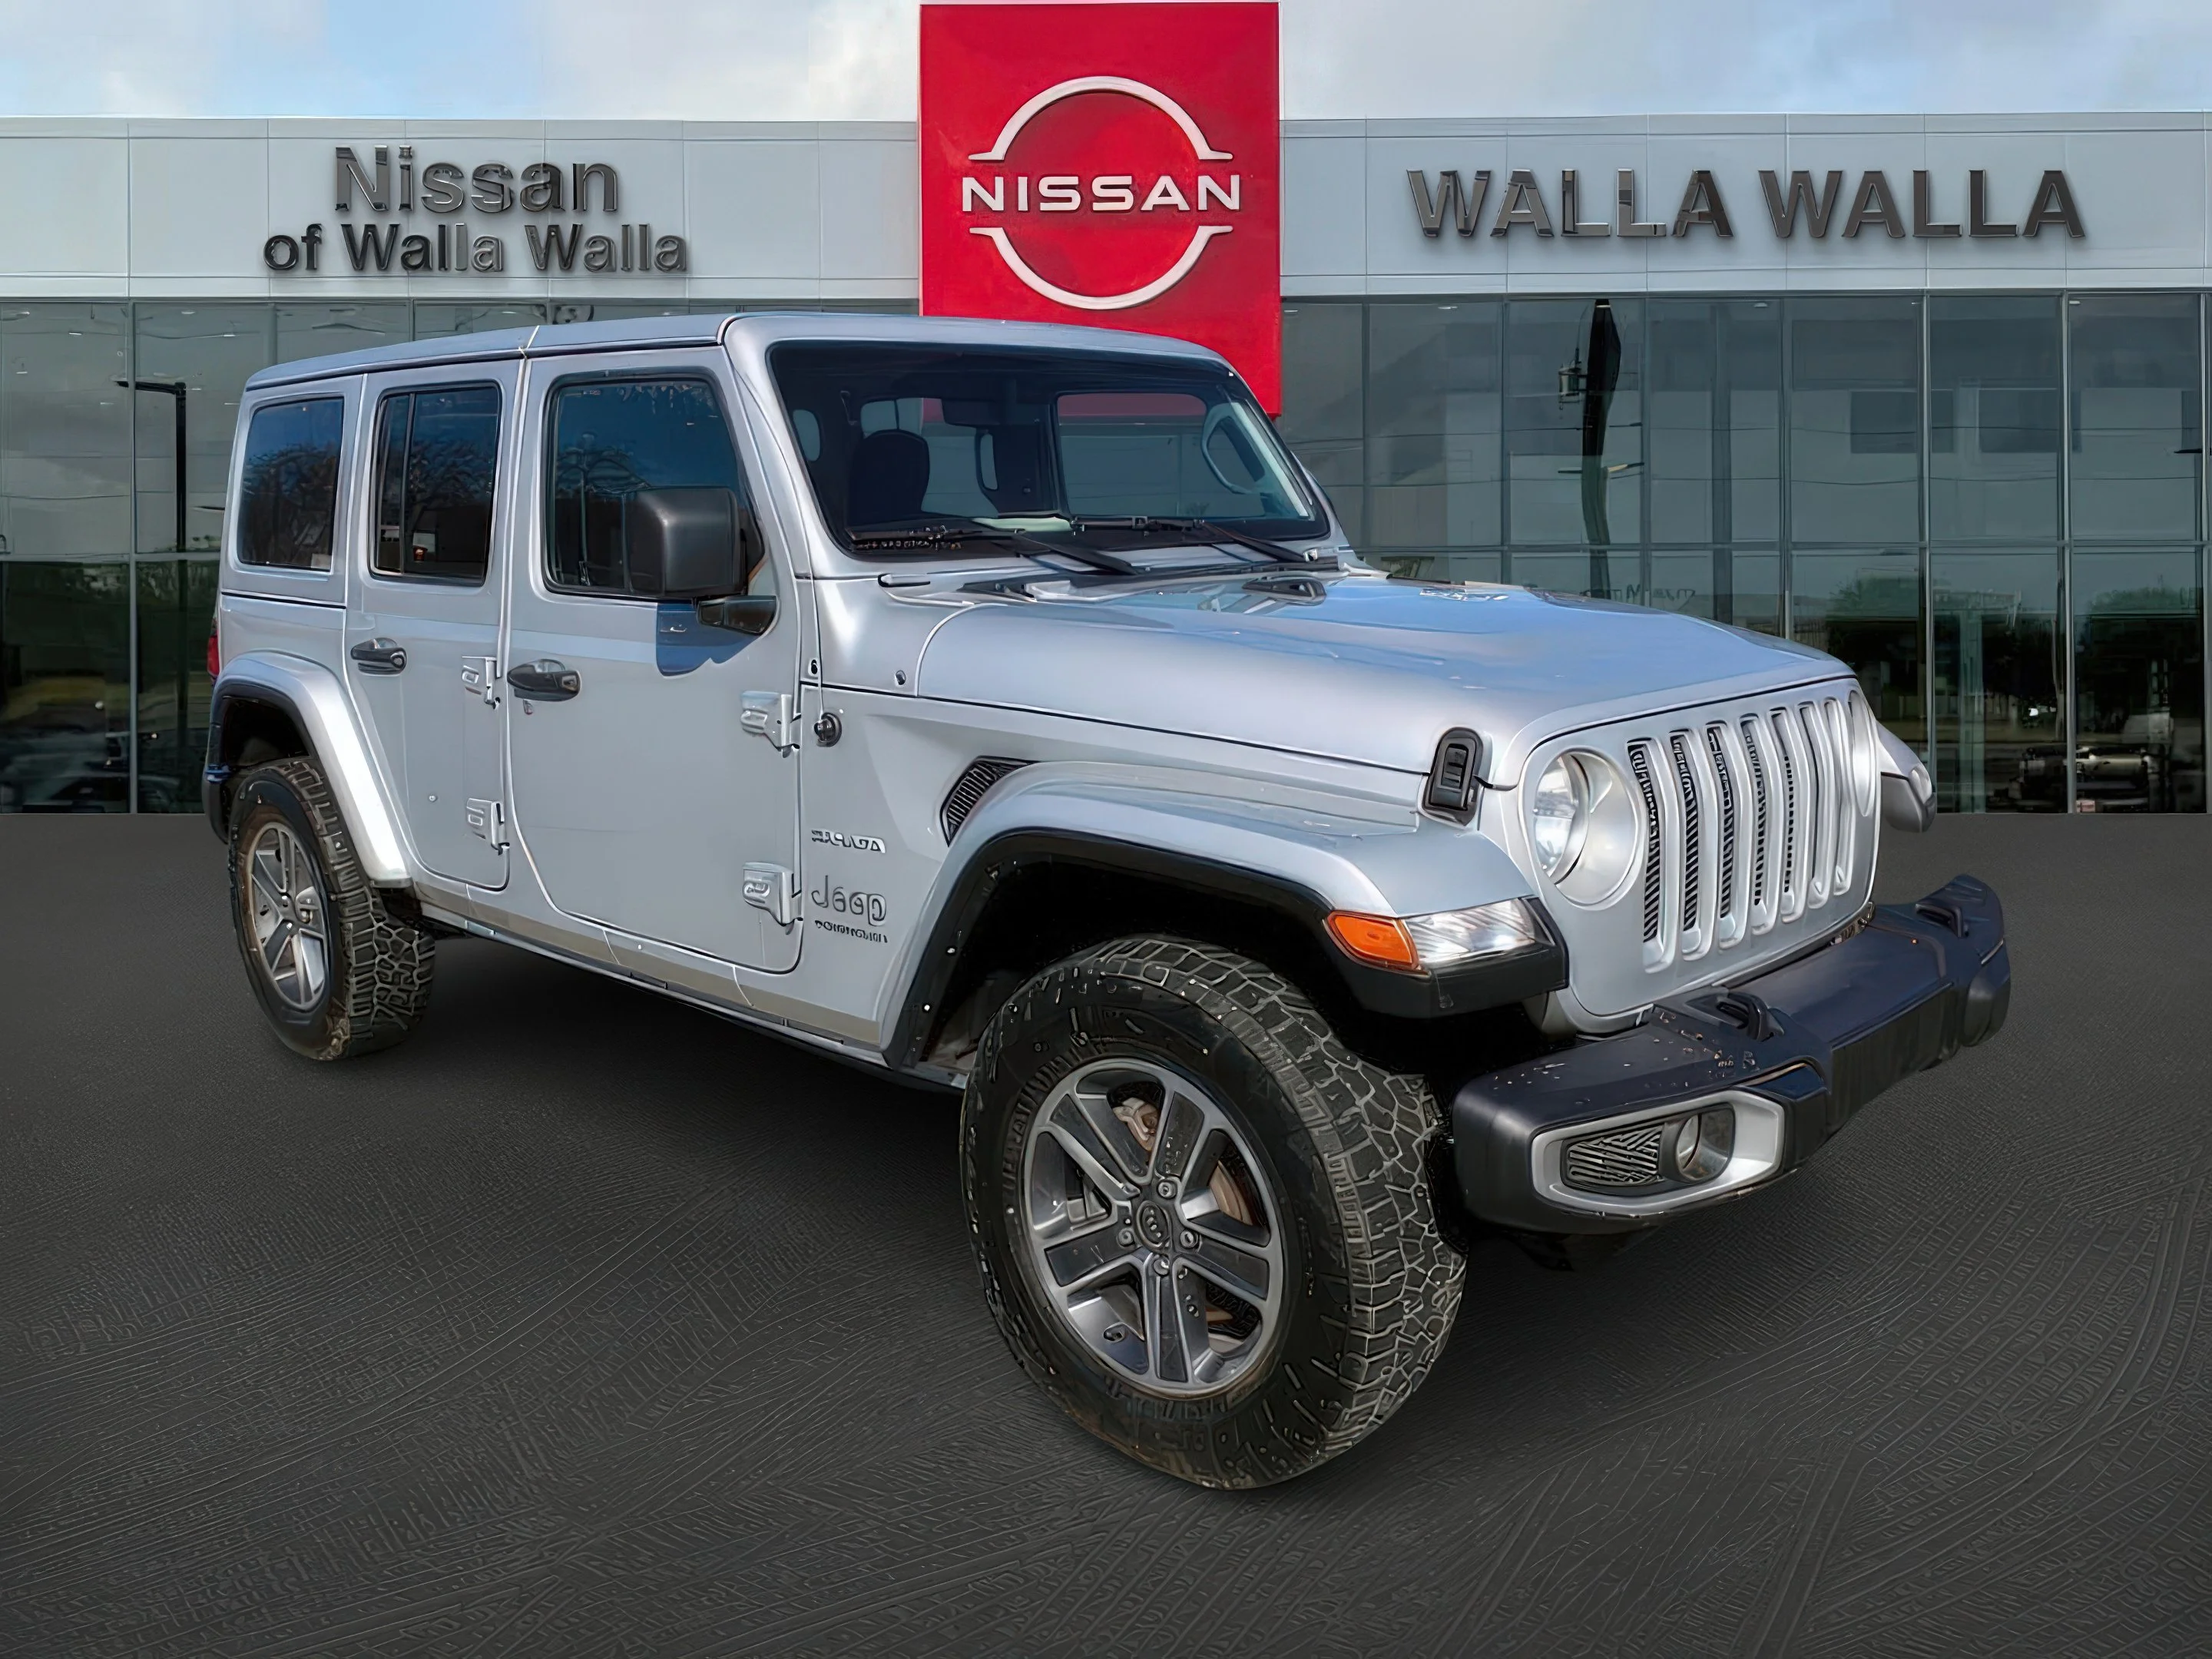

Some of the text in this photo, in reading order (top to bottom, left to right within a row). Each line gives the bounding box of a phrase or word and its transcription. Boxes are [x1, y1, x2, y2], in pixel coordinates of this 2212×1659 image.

[334, 144, 618, 213] Nissan
[962, 175, 1240, 211] NISSAN
[1406, 168, 2086, 238] WALLA WALLA
[263, 223, 687, 272] of Walla Walla
